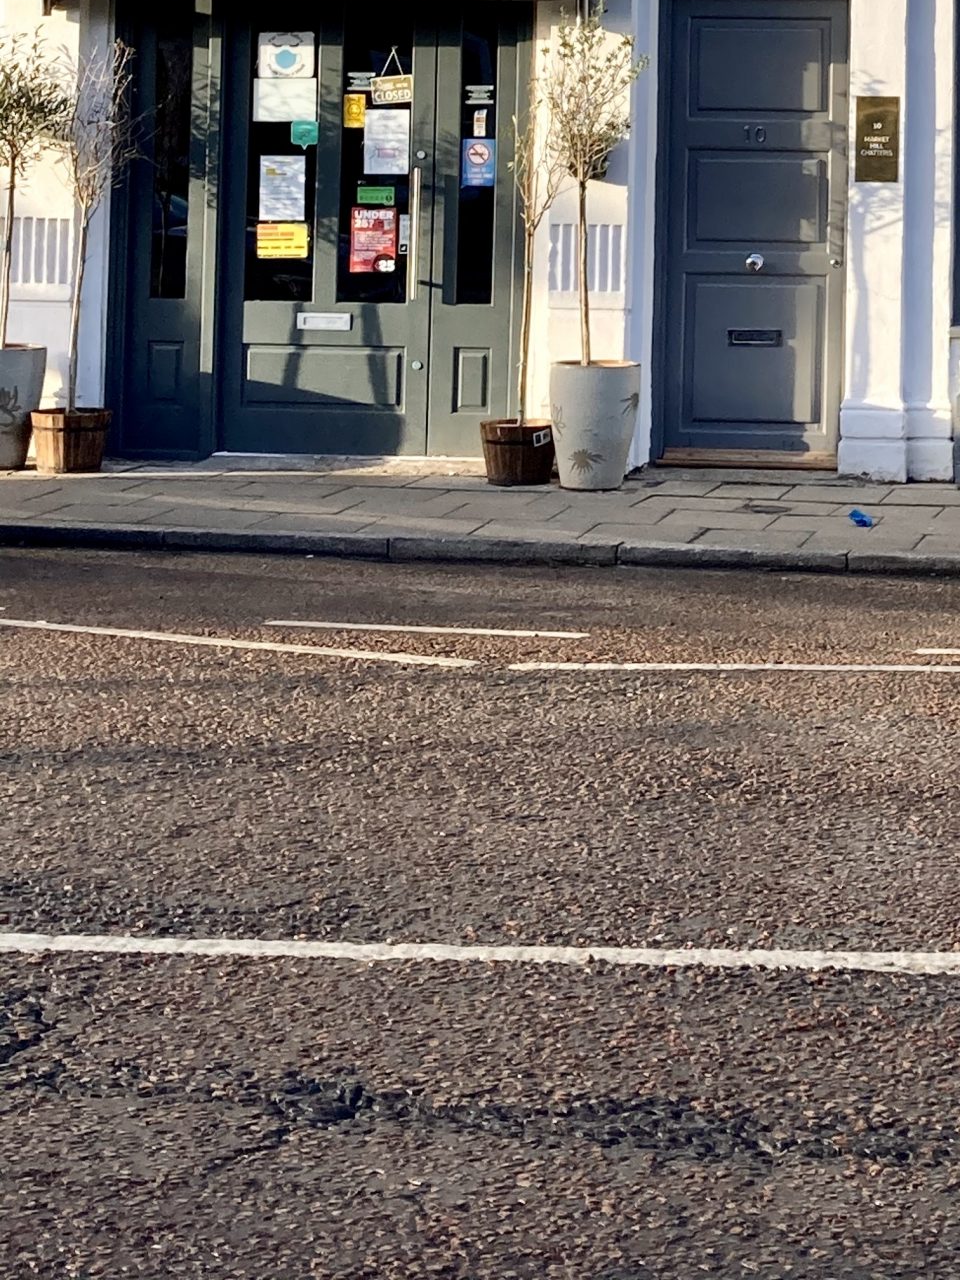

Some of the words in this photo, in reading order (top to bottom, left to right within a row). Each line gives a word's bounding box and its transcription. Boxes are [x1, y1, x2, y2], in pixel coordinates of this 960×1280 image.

[374, 90, 412, 101] CLOSED
[873, 122, 883, 130] 10
[743, 125, 767, 143] 10
[354, 210, 394, 220] UNDER
